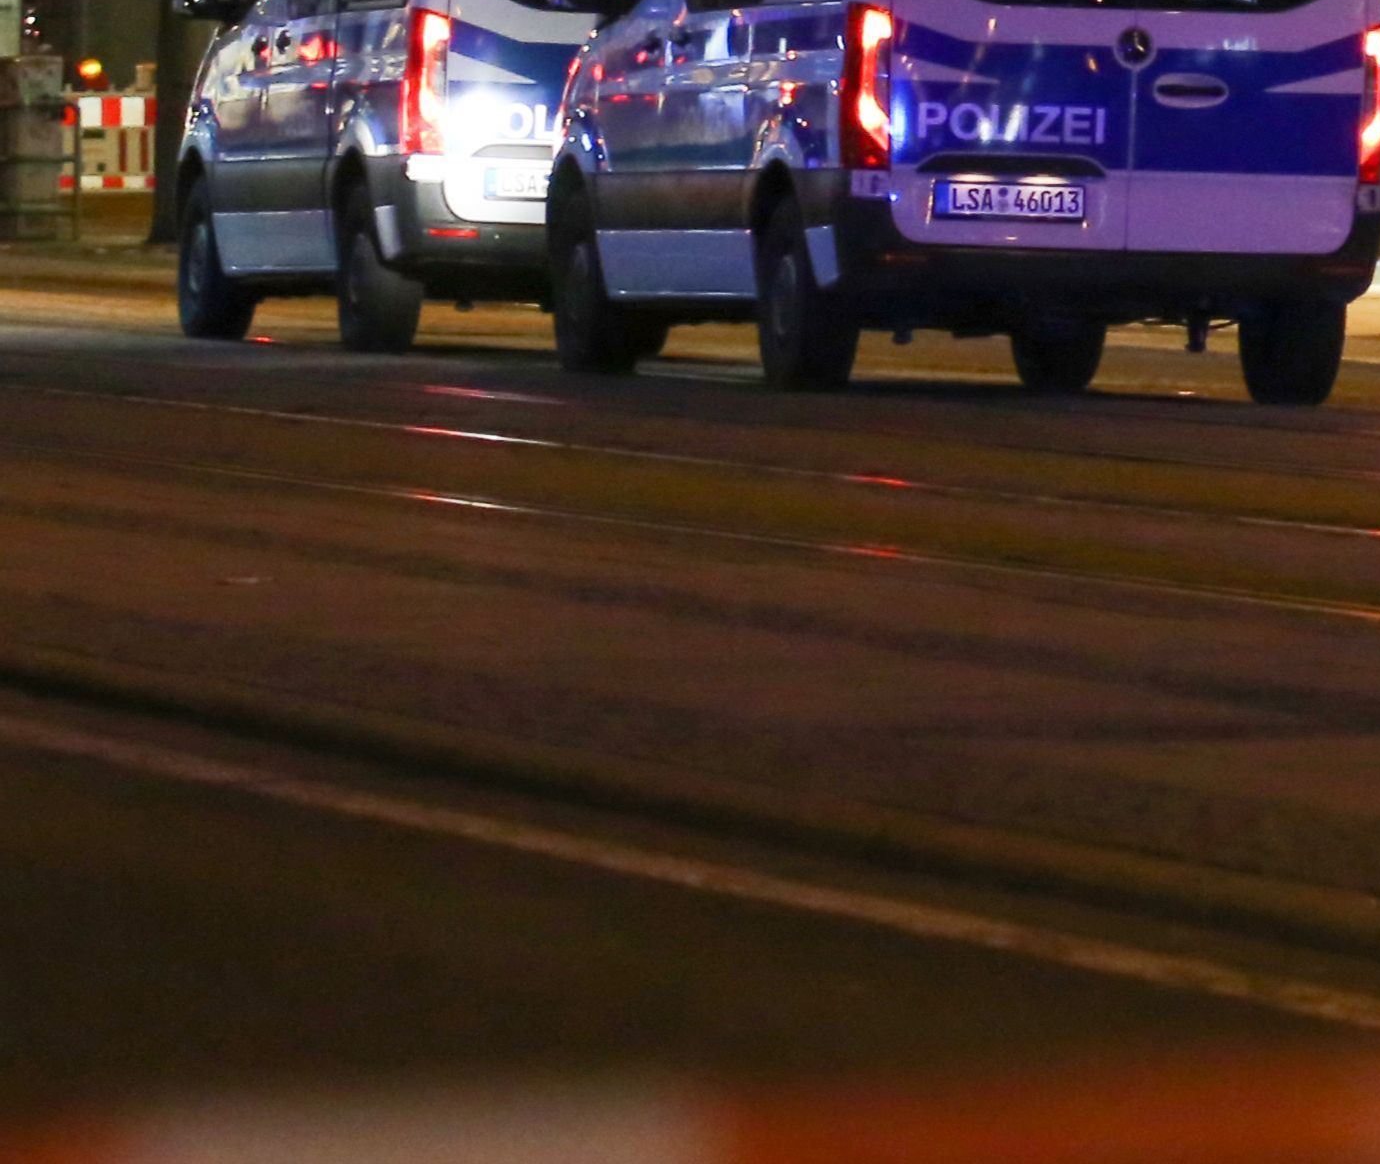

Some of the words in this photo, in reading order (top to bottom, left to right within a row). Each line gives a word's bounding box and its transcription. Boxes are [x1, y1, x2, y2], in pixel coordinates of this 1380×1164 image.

[917, 101, 1106, 145] POLIZEI
[951, 186, 994, 212] LSA
[1013, 189, 1081, 215] 46013
